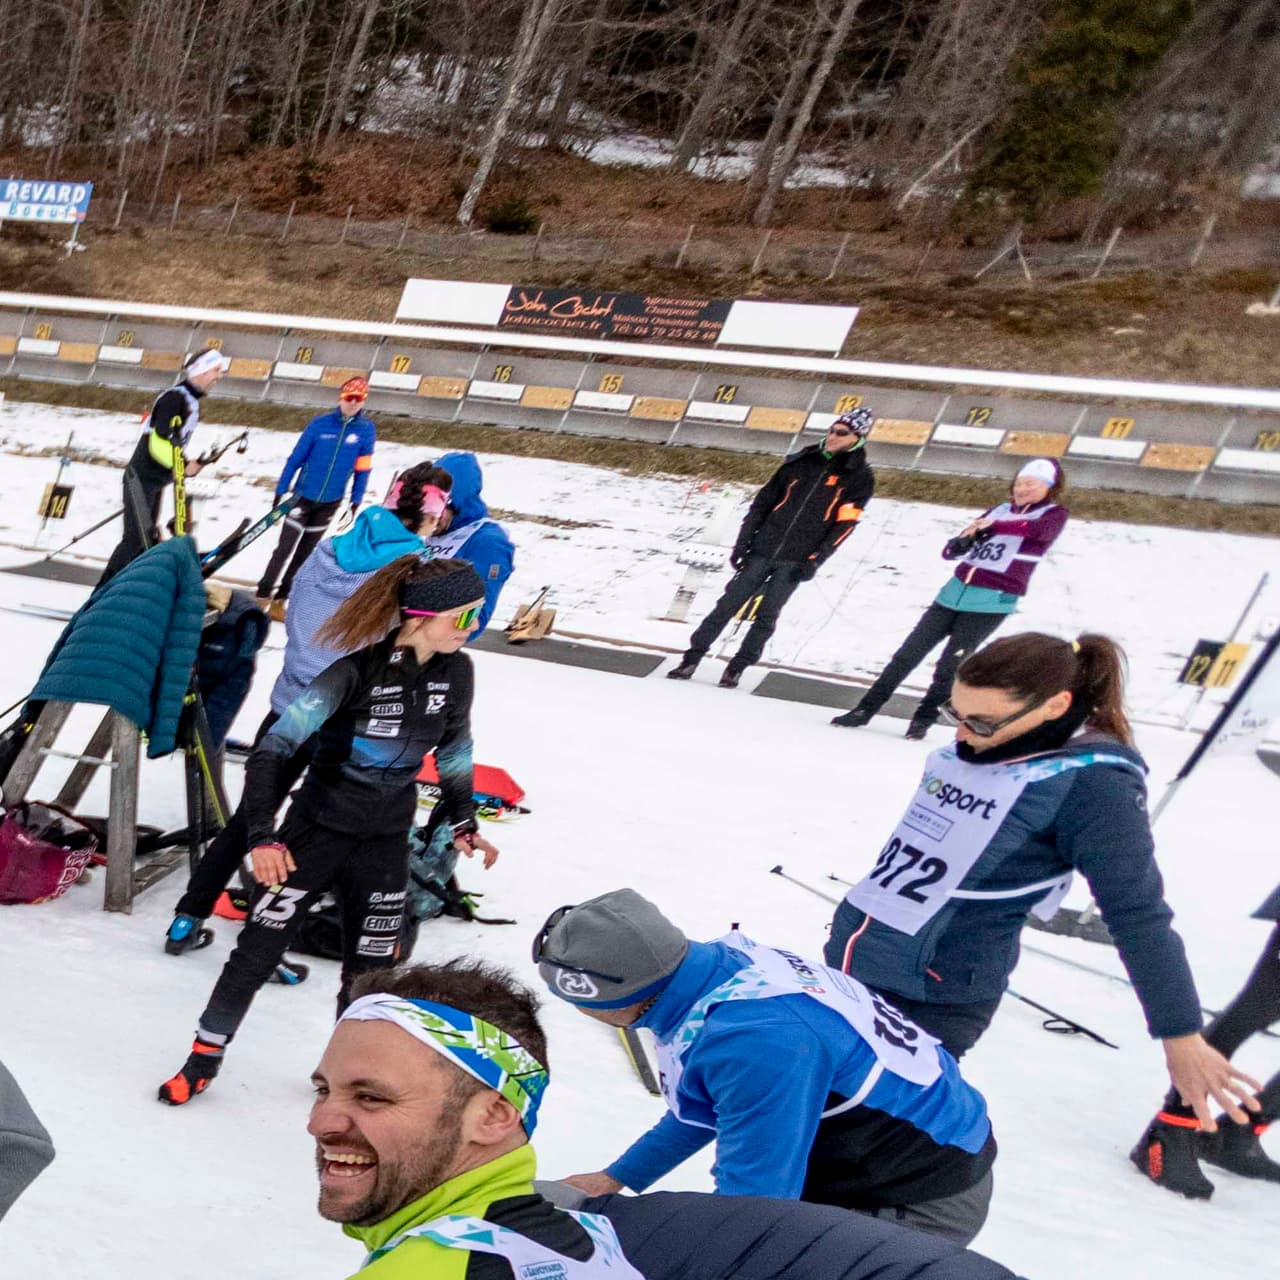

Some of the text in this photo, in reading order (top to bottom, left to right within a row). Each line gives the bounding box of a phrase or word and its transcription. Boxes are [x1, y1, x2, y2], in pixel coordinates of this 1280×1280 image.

[5, 180, 87, 204] REVARD
[506, 291, 548, 312] John
[50, 494, 68, 518] 14
[1183, 655, 1238, 687] 12 11
[925, 771, 997, 820] osport
